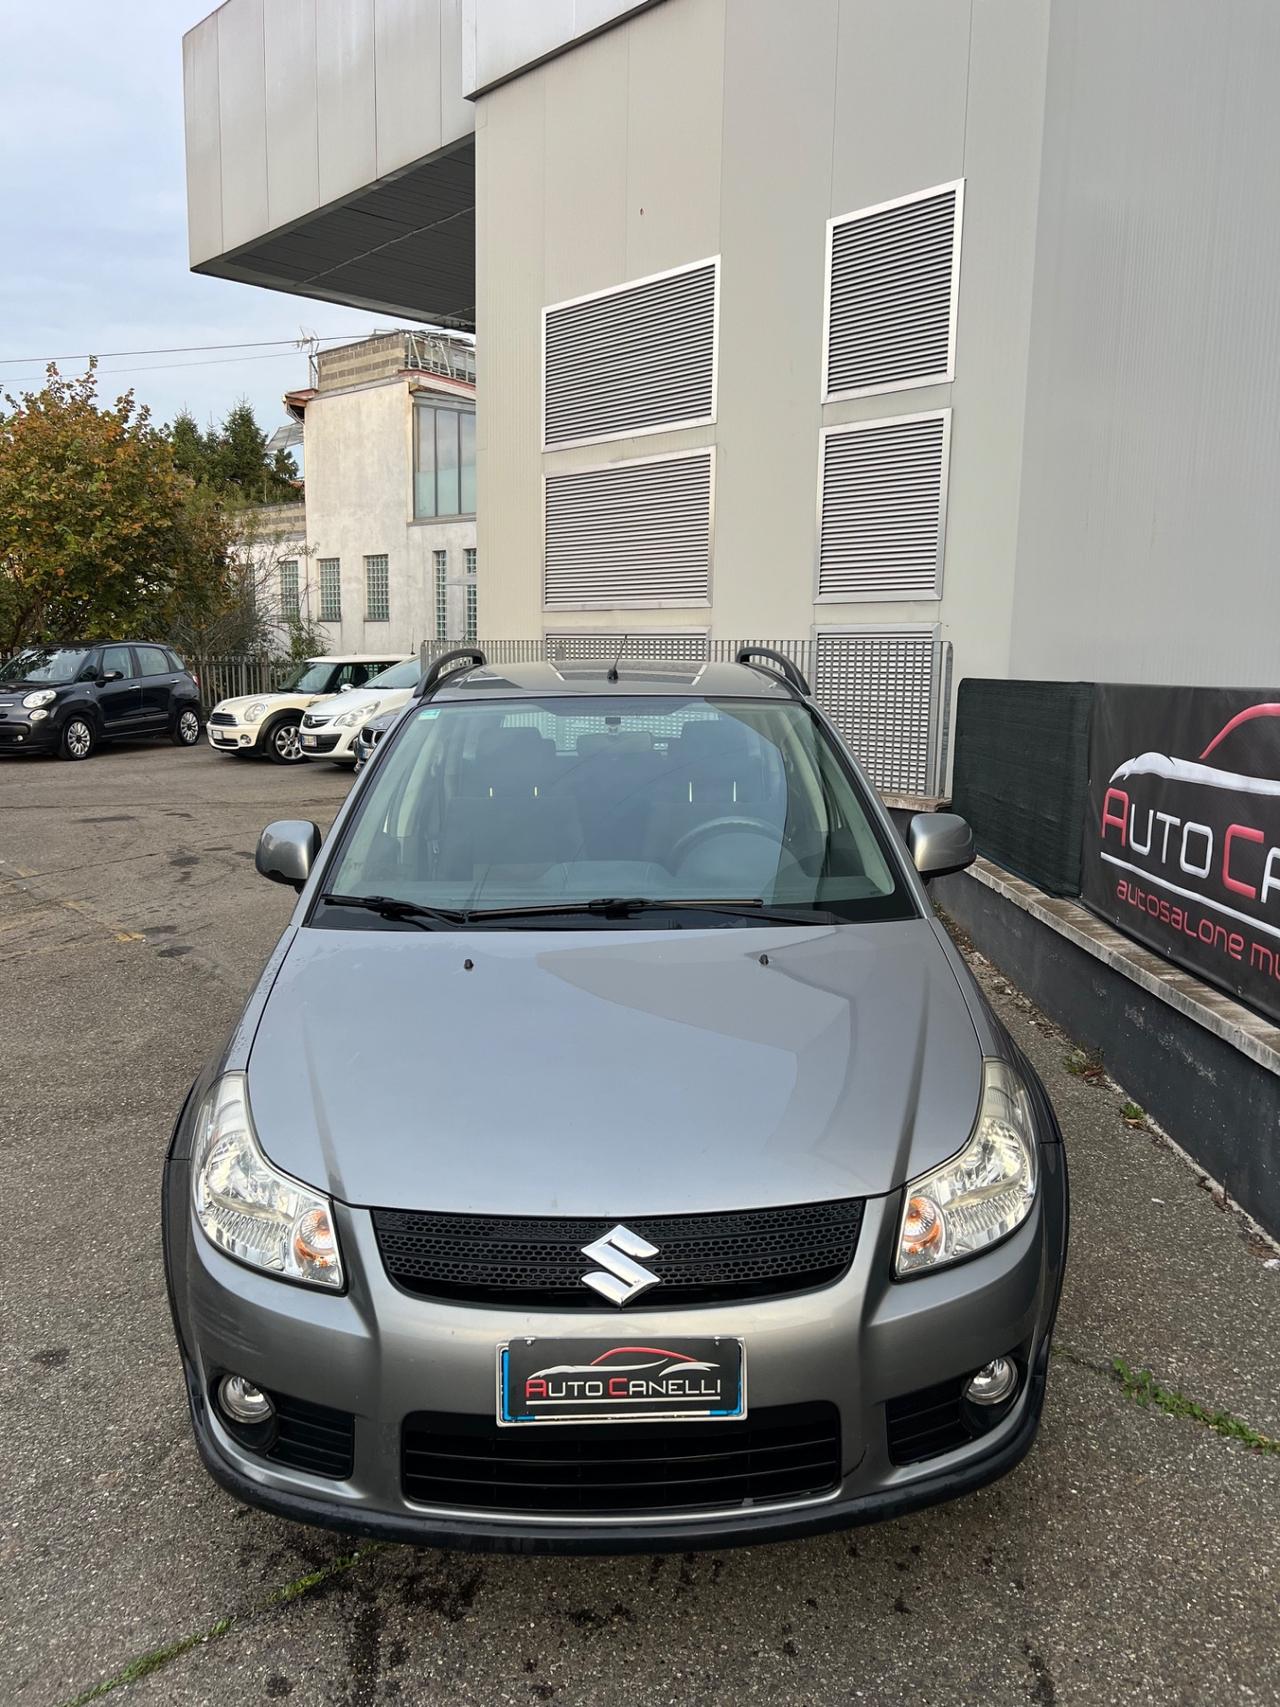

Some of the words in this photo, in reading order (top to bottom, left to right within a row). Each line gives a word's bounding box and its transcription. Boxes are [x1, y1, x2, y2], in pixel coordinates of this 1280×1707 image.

[1101, 787, 1214, 879] AUTO
[1250, 942, 1280, 981] m
[525, 1379, 603, 1398] AUTO
[608, 1378, 721, 1397] CANELLI
